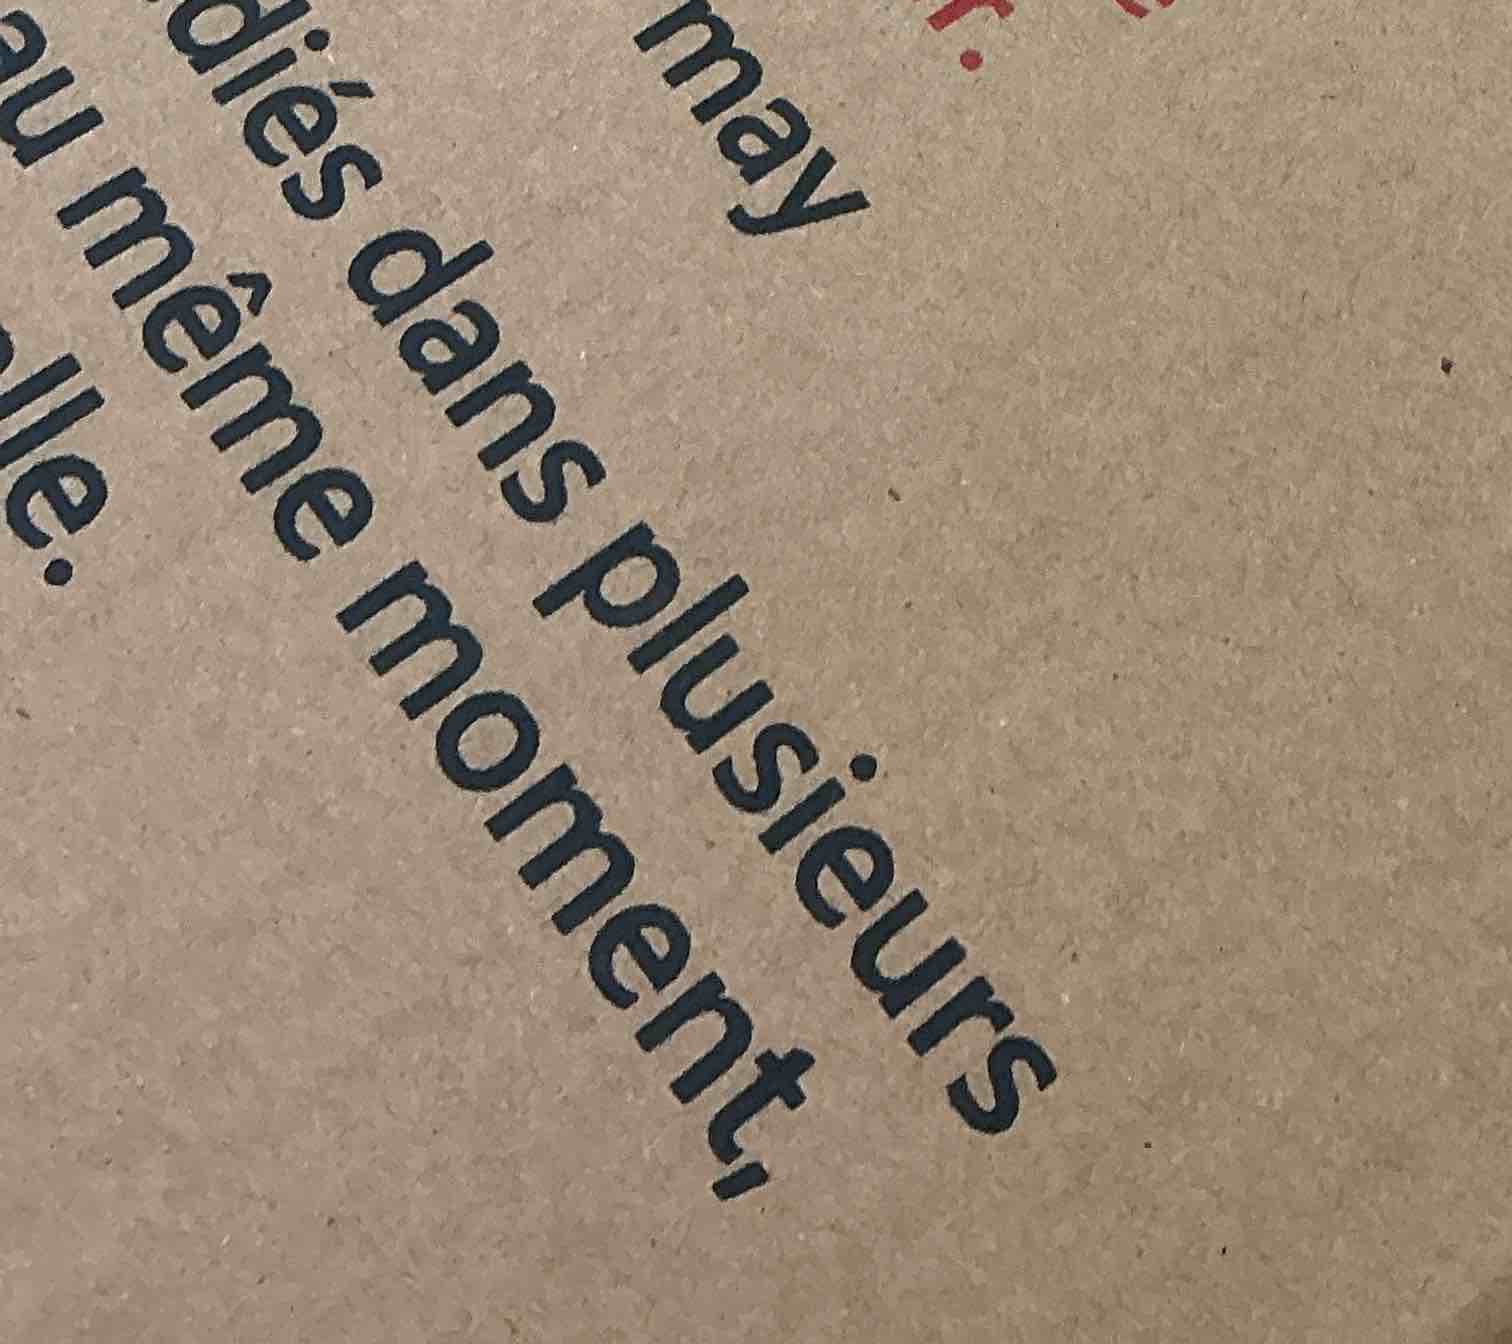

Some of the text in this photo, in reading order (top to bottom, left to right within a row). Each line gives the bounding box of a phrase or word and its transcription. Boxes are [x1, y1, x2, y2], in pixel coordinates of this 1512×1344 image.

[0, 321, 109, 586] lle.
[56, 167, 374, 561] même
[336, 561, 817, 1201] moment,
[348, 228, 606, 522] dans
[532, 521, 1058, 1134] plusieurs
